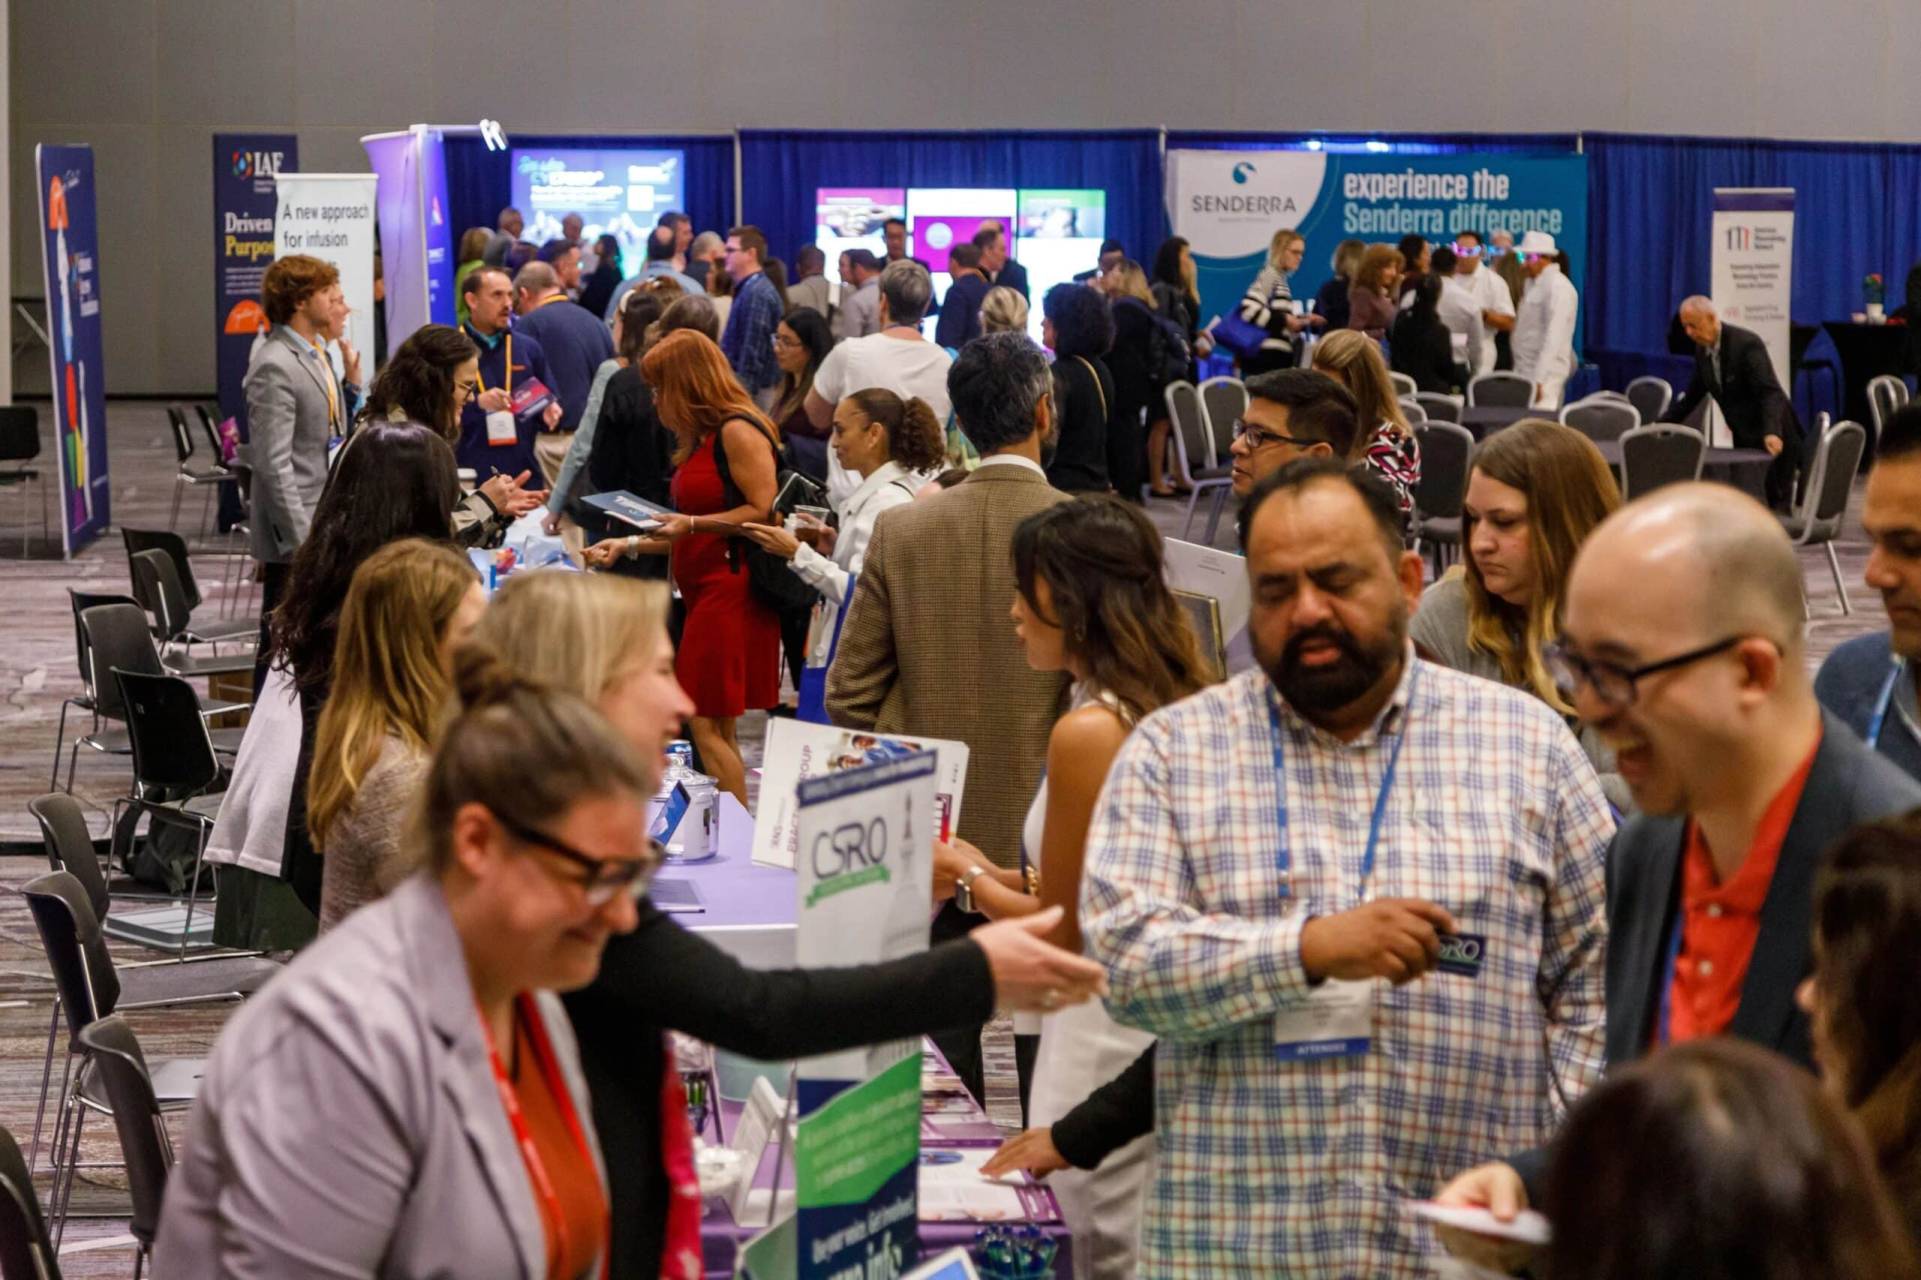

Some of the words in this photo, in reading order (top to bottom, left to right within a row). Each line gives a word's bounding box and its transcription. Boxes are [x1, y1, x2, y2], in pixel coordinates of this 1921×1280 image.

[254, 152, 283, 176] IAF
[1343, 168, 1468, 203] experience
[1473, 168, 1509, 200] the
[282, 203, 292, 220] A
[295, 207, 318, 219] new
[321, 204, 369, 222] approach
[1192, 194, 1297, 215] SENDERRA
[225, 211, 273, 233] Driven
[1343, 203, 1444, 234] Senderra
[1449, 203, 1563, 234] difference
[283, 230, 303, 248] for
[306, 230, 348, 248] infusion
[799, 744, 812, 782] ROUP
[812, 816, 887, 880] CSRO
